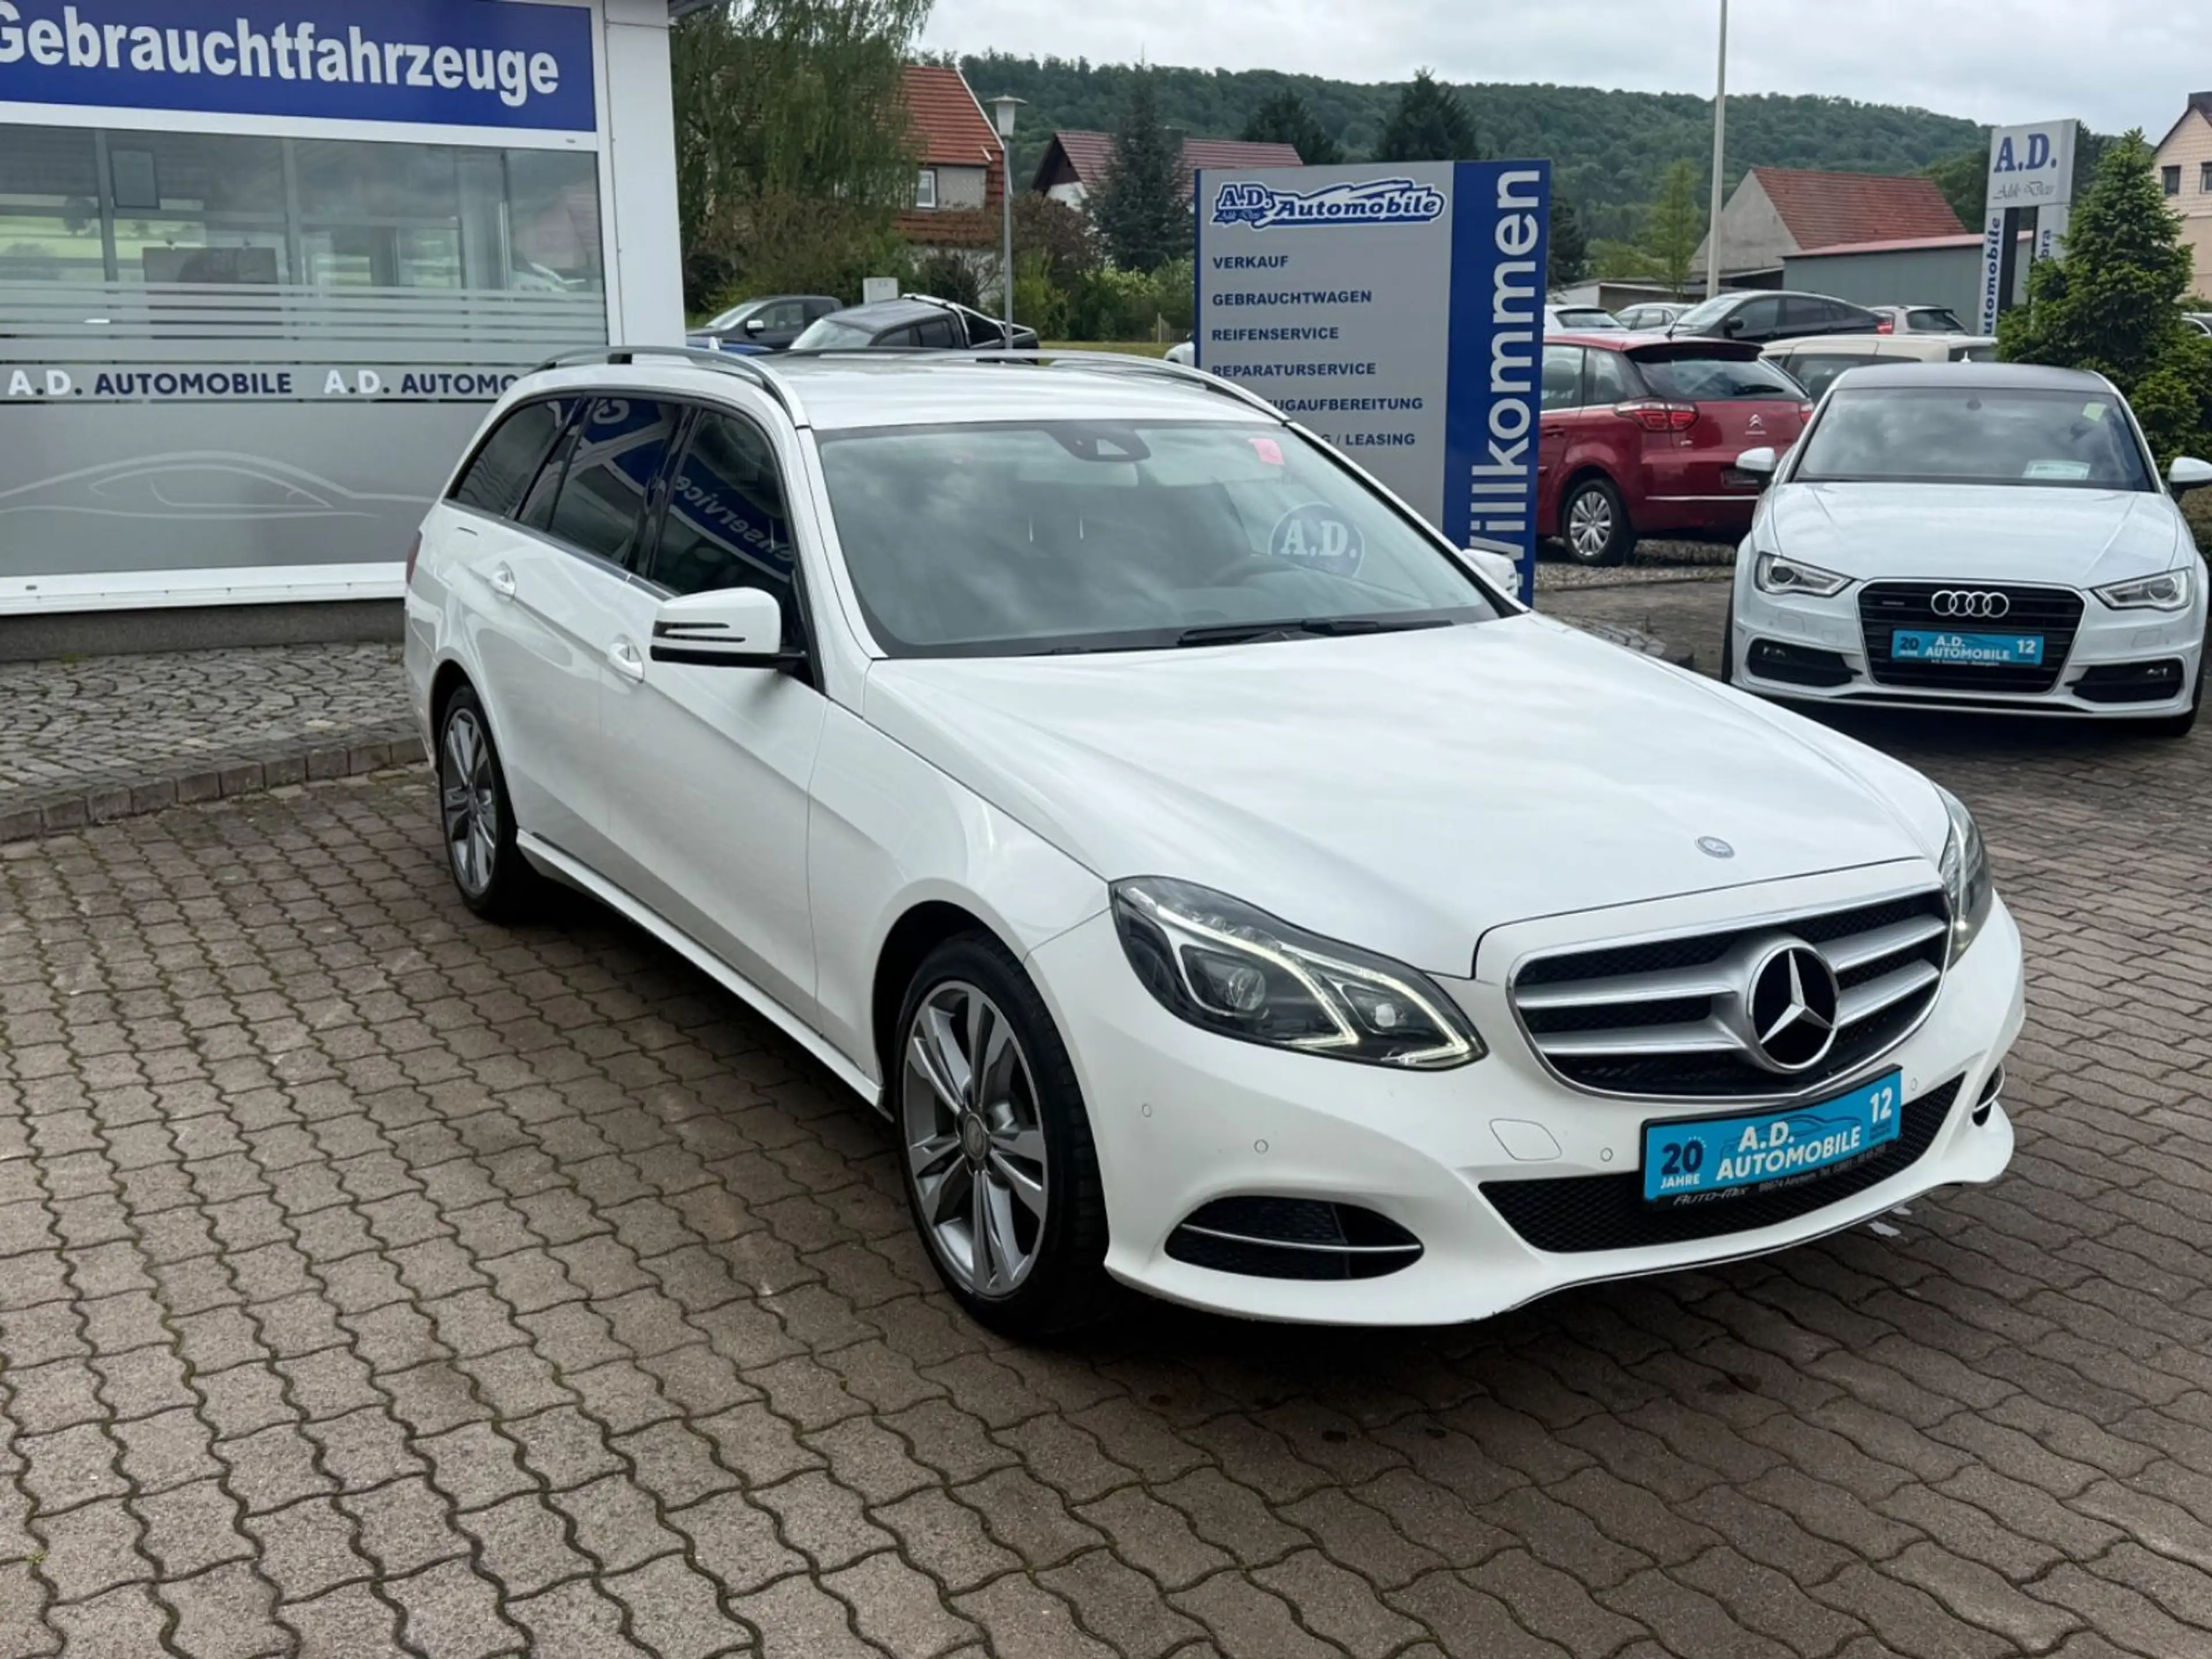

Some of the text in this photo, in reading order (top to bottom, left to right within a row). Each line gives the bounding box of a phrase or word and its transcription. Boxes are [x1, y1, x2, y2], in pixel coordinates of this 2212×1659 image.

[0, 0, 560, 107] Gebrauchtfahrzeuge
[1994, 132, 2057, 173] A.D.
[1219, 187, 1272, 209] A.D.
[1274, 194, 1437, 217] Automobile
[1213, 255, 1289, 270] VERKAUF
[1984, 217, 2000, 334] utomobile
[1212, 290, 1372, 306] GEBRAUCHTWAGEN
[1212, 327, 1339, 341] REIFENSERVICE
[1212, 362, 1377, 377] REPARATURSERVICE
[8, 369, 292, 396] A.D. AUTOMOBILE
[323, 370, 391, 395] A.D.
[1346, 433, 1415, 446] LEASING
[1280, 519, 1357, 556] A.D.
[1900, 636, 2036, 653] 20 A.D. 12
[1925, 647, 2010, 660] AUTOMOBILE
[1661, 1087, 1892, 1176] 20 A.D. 12
[1716, 1126, 1861, 1181] AUTOMOBILE
[1660, 1173, 1700, 1190] JAHRE
